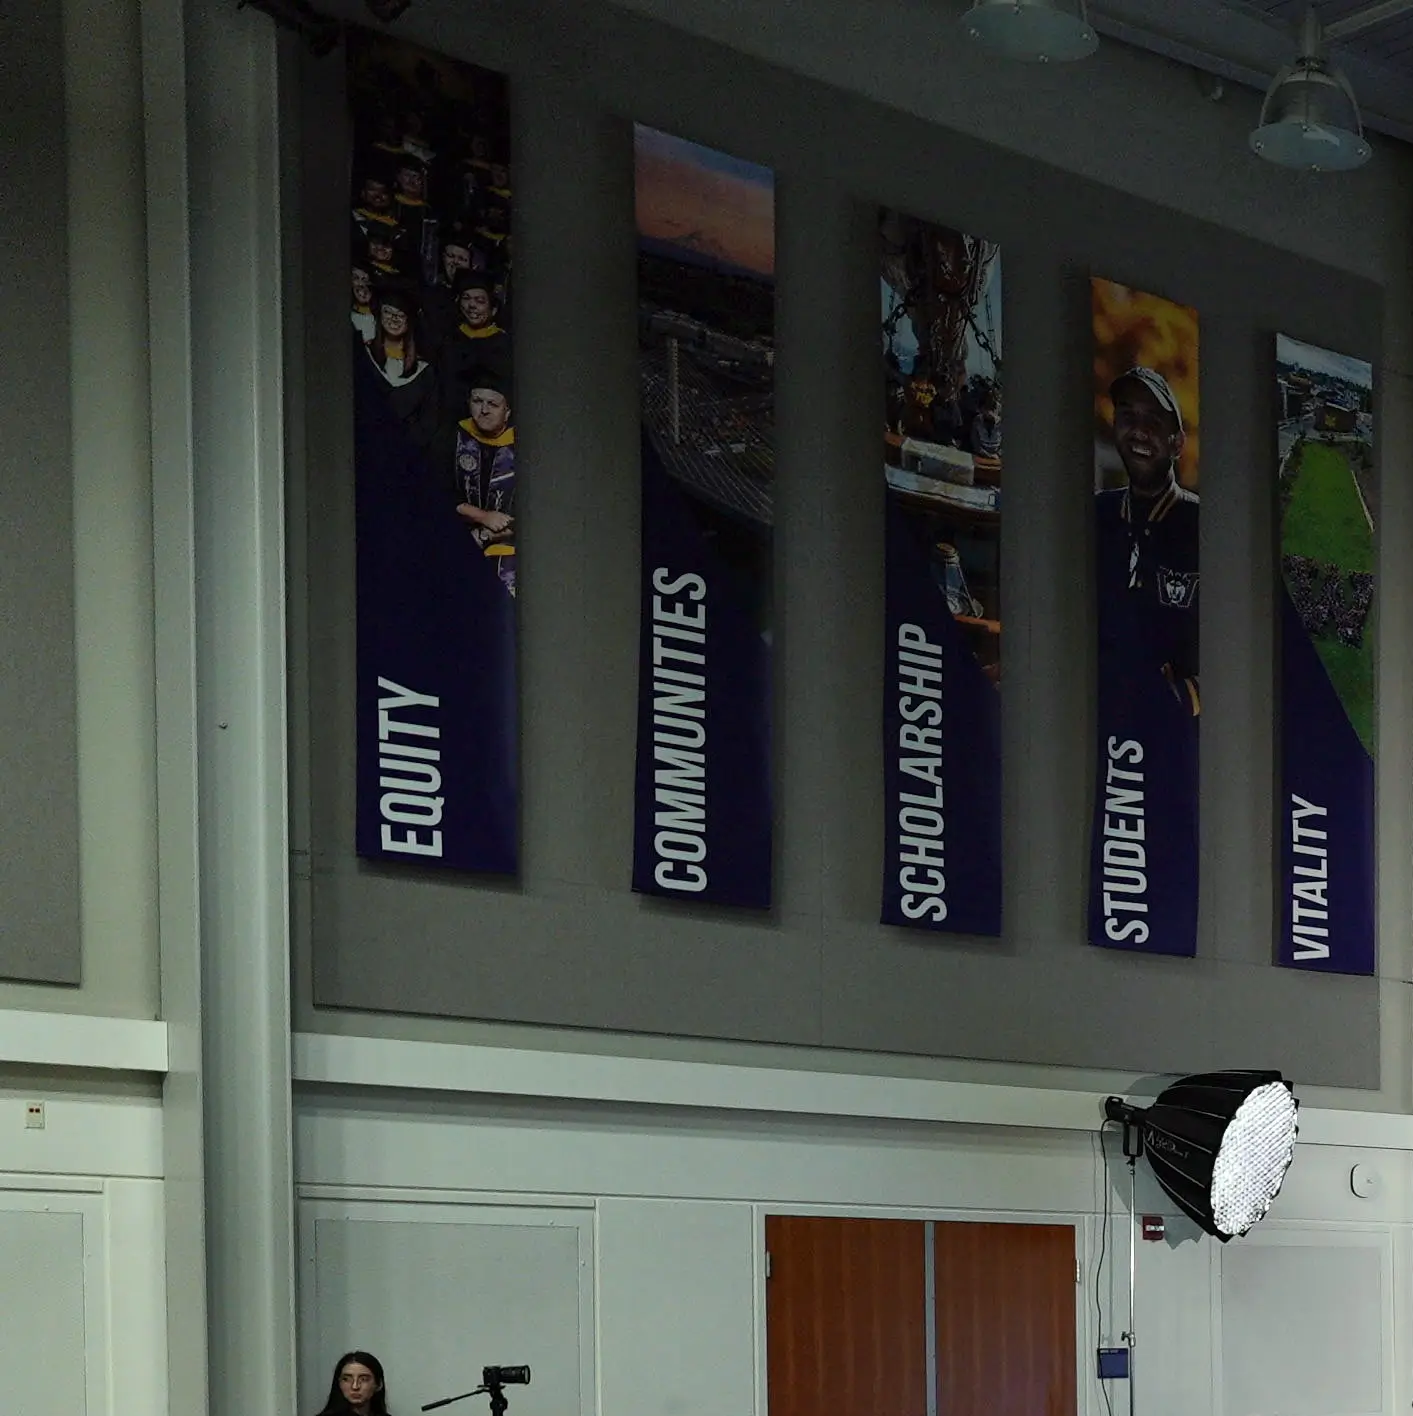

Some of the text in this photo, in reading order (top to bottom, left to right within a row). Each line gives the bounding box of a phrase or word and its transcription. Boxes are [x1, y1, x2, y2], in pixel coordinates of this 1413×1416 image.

[377, 676, 445, 858] EQUITY
[652, 567, 707, 892] COMMUNITIES
[899, 622, 948, 922] SCHOLARSHIP
[1103, 735, 1150, 944] STUDENTS
[1291, 793, 1329, 960] VITALITY
